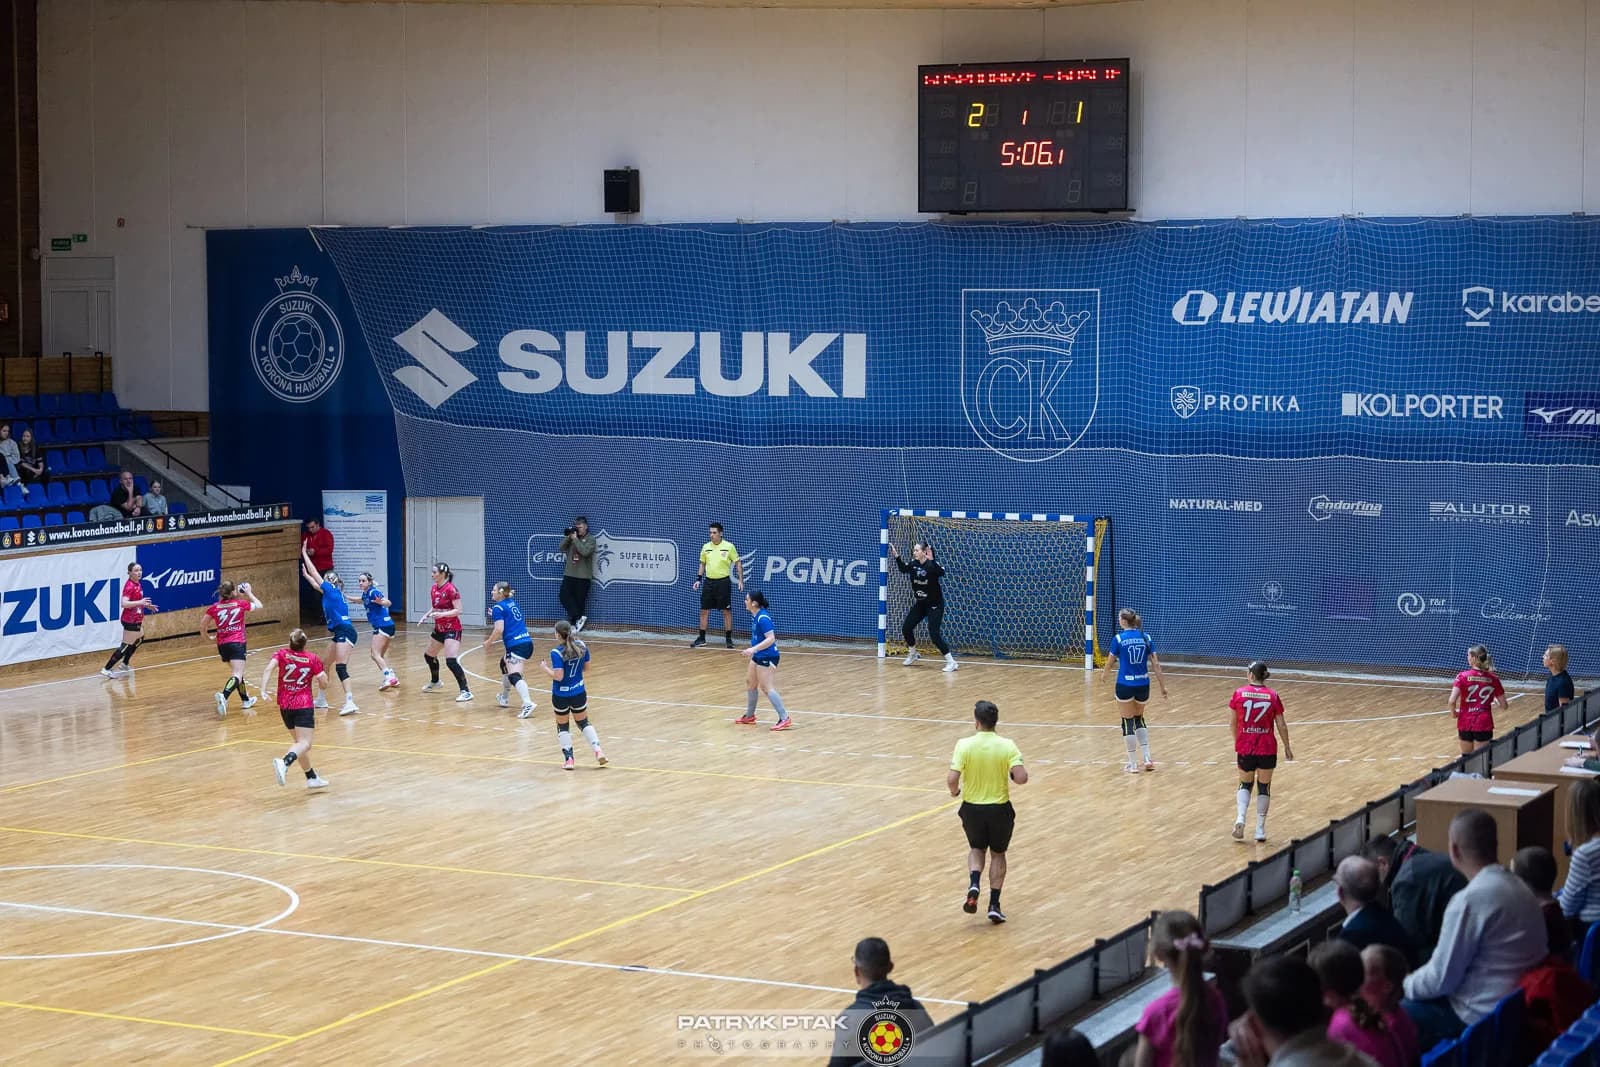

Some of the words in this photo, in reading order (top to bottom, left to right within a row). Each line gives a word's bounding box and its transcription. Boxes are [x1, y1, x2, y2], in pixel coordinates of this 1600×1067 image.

[968, 103, 984, 127] 2
[1022, 110, 1027, 125] 1
[1076, 101, 1083, 123] 1
[280, 300, 314, 314] SUZUKI
[1221, 286, 1414, 325] LEWIATAN
[1502, 290, 1600, 313] karabe
[497, 329, 867, 399] SUZUKI
[260, 356, 293, 393] KORONA
[295, 356, 335, 394] HANDBALL
[976, 357, 1073, 440] CK
[1204, 394, 1300, 412] PROFIKA
[1355, 392, 1503, 419] KOLPORTER
[1169, 498, 1263, 512] NATURAL-MED
[1316, 500, 1383, 511] endorfina
[1443, 502, 1531, 515] ALUTOR
[187, 509, 273, 525] www.koronahandball.pl
[49, 520, 145, 541] www.koronahandball.pl
[619, 552, 671, 561] SUPERLIGA
[763, 556, 868, 587] PGNiG
[0, 578, 120, 636] ZUKI
[217, 607, 241, 626] 32
[511, 606, 522, 622] 8
[1127, 644, 1146, 664] 17
[568, 657, 580, 677] 7
[1465, 684, 1495, 705] 29
[1243, 699, 1272, 722] 17
